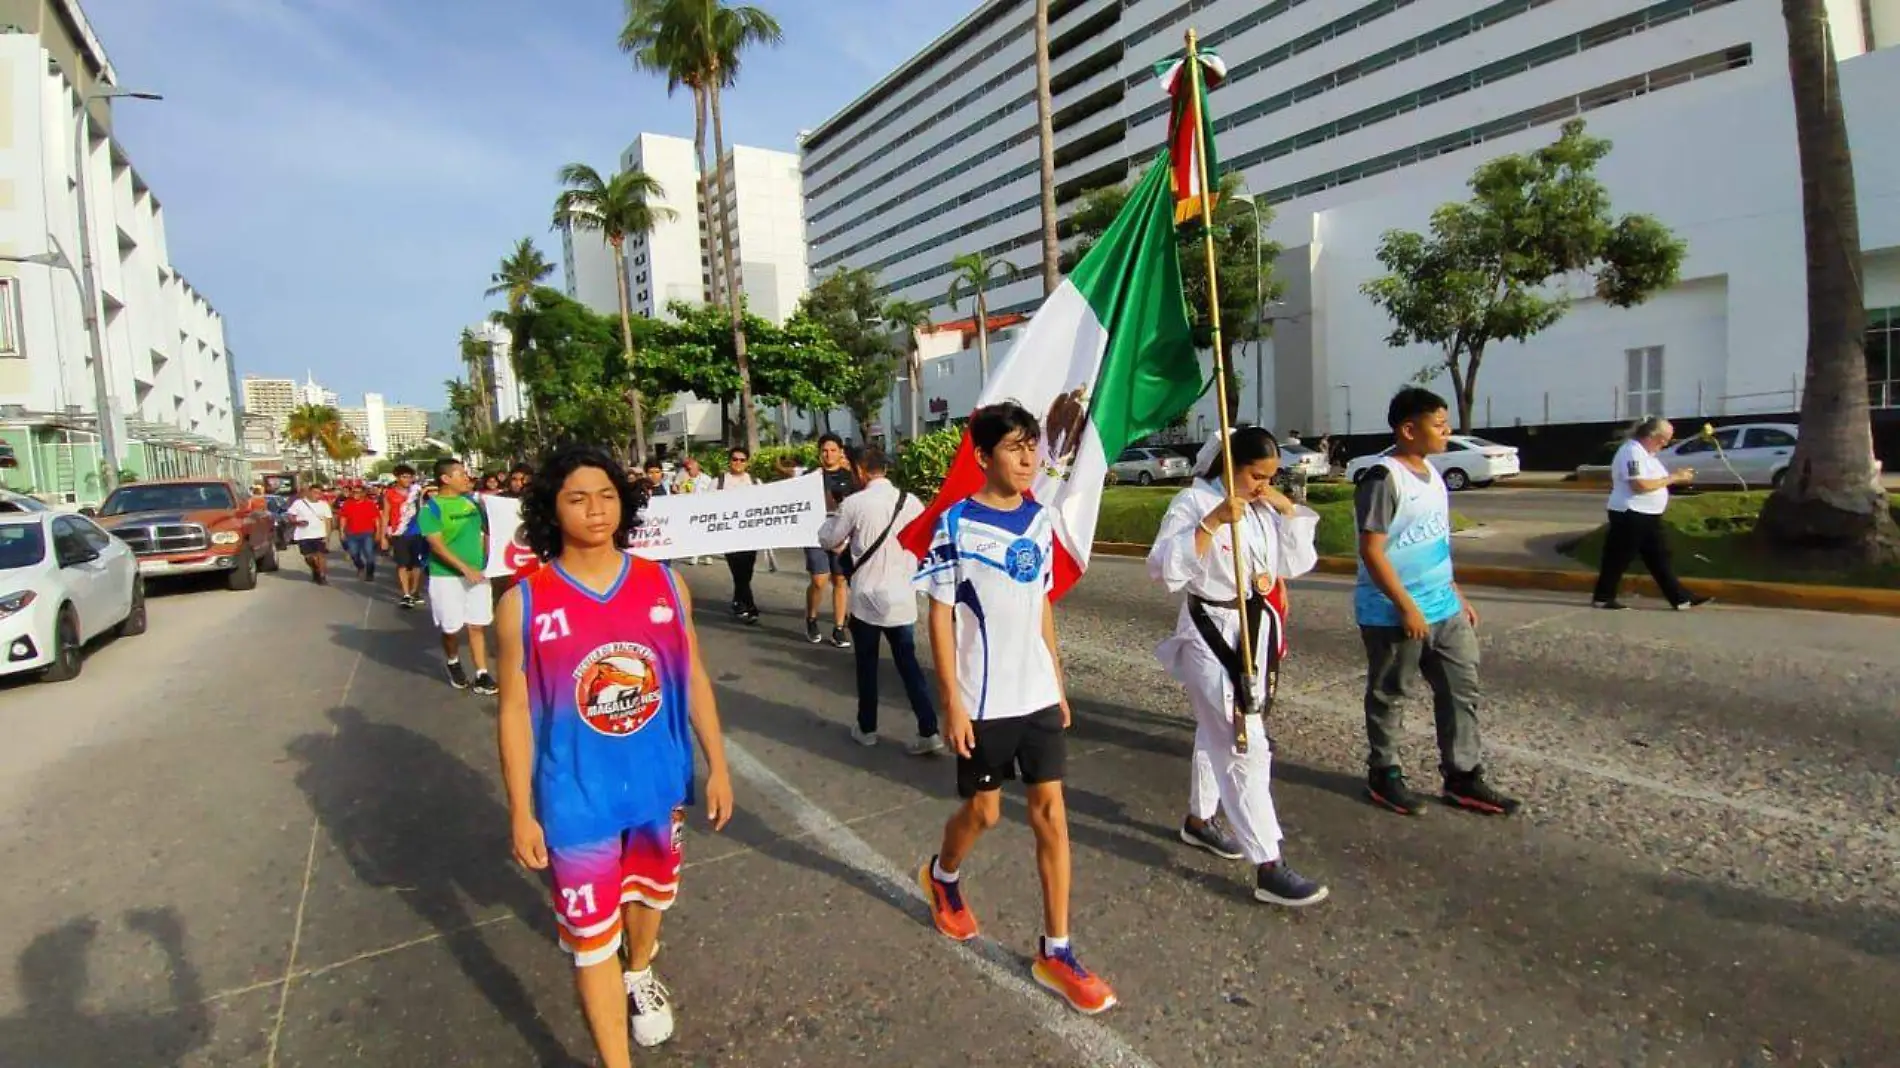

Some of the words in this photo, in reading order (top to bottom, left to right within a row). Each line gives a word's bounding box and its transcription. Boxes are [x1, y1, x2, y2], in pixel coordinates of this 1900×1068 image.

[690, 512, 717, 524] POR
[723, 511, 739, 520] LA
[745, 501, 811, 518] GRANDEZA
[707, 521, 732, 532] DEL
[739, 514, 798, 529] DEPORTE
[535, 607, 571, 642] 21
[561, 883, 597, 917] 21
